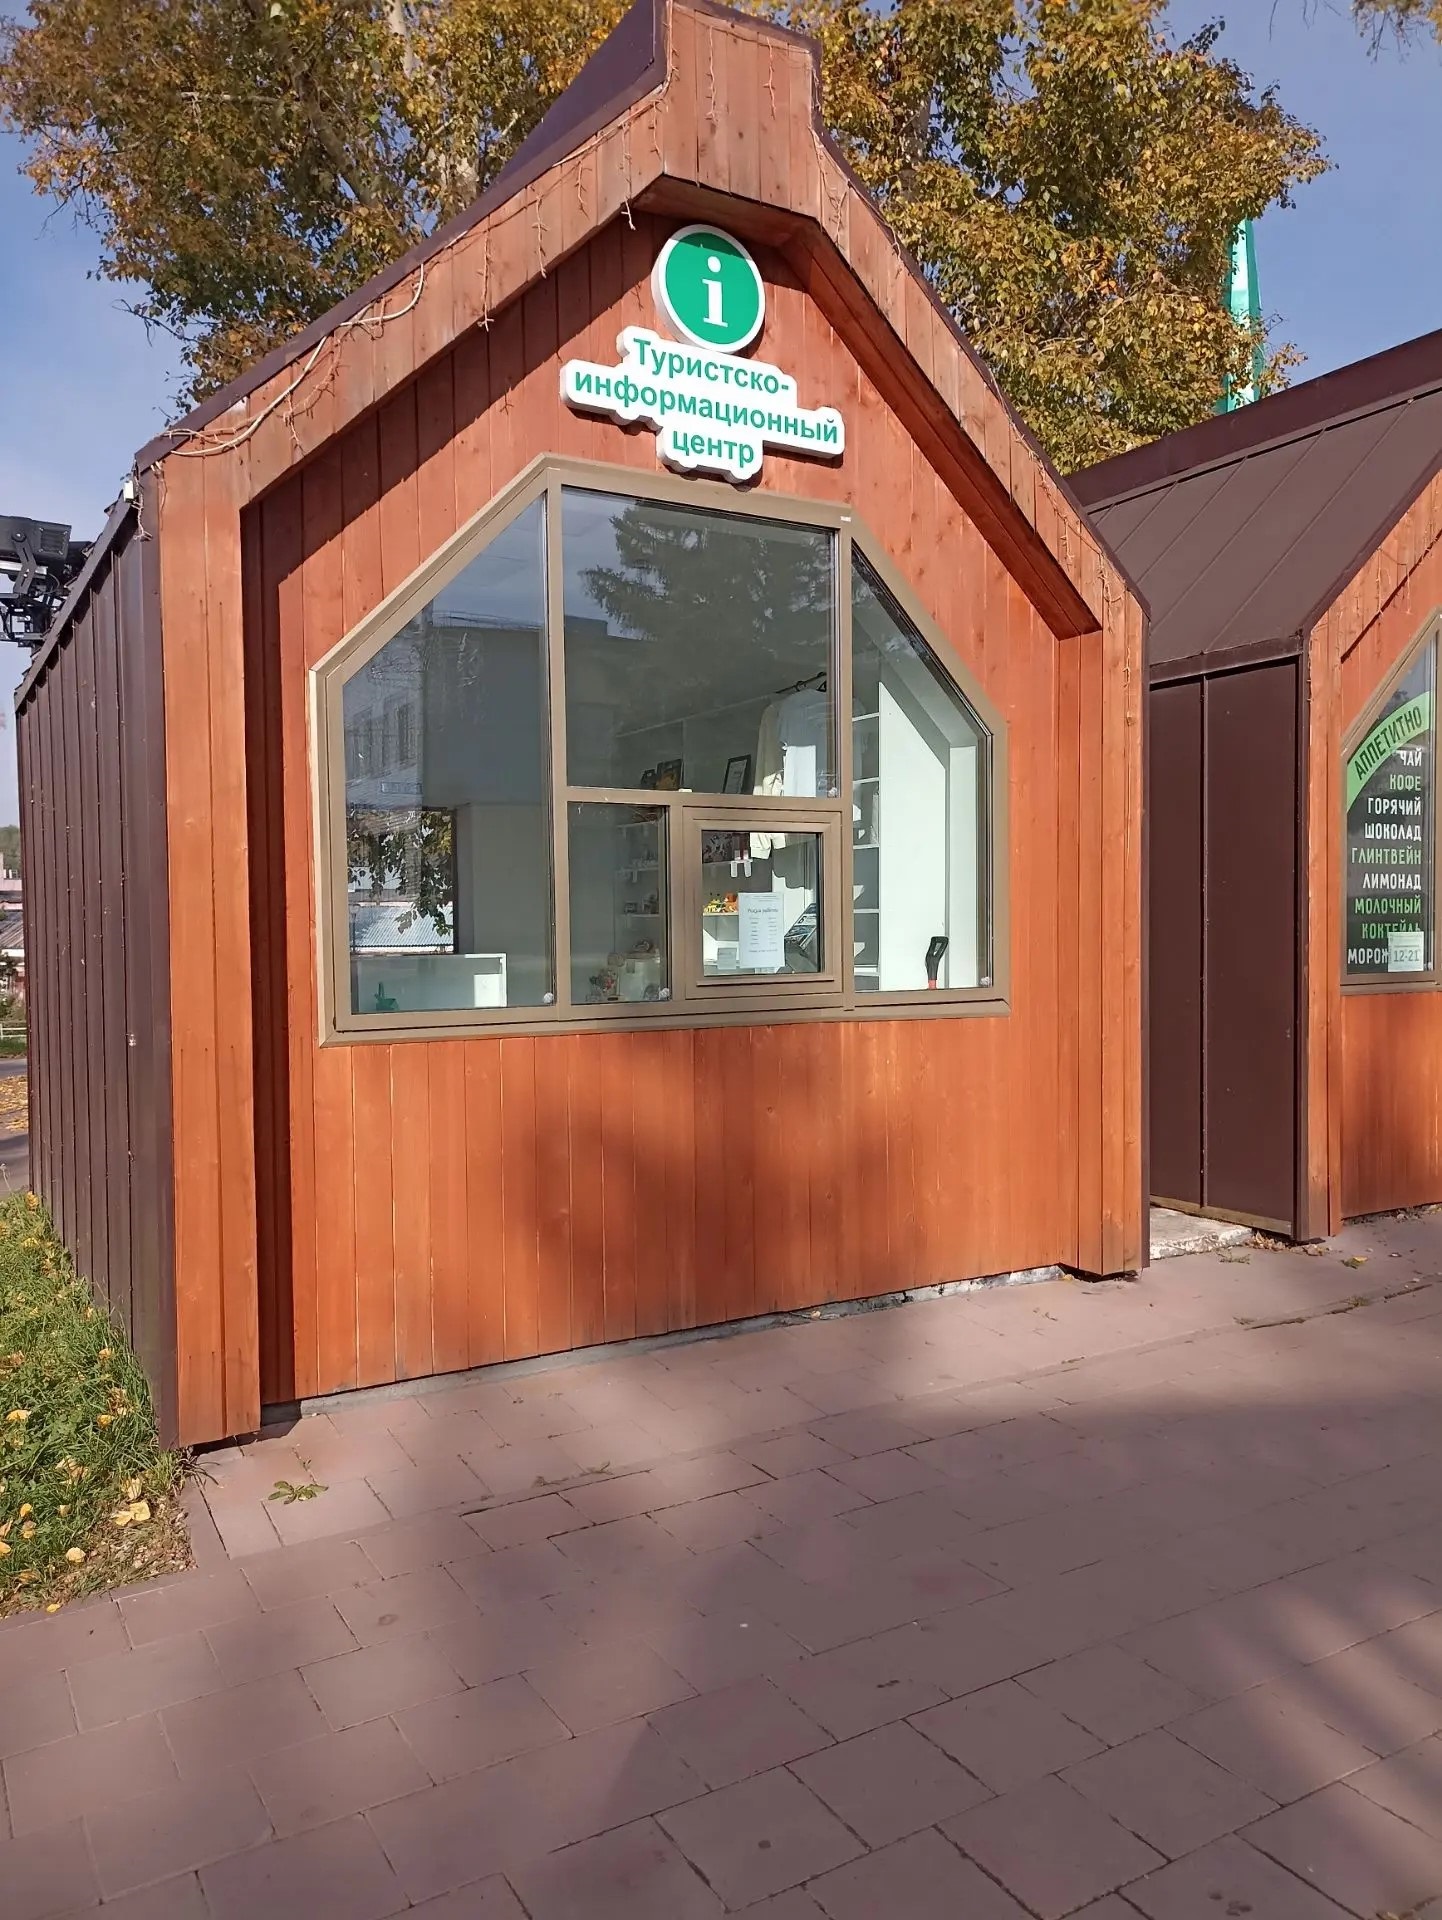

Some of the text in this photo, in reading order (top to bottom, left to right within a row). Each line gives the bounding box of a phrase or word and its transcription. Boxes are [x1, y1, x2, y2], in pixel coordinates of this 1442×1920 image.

[632, 337, 790, 394] Туристско-
[574, 370, 838, 444] информационный
[672, 429, 755, 468] центр
[1354, 705, 1423, 781] АППЕТИТНО
[1399, 747, 1422, 767] ЧАЙ
[1389, 774, 1422, 791] КОФЕ
[1367, 796, 1422, 816] ГОРЯЧИЙ
[1364, 822, 1422, 842] ШОКОЛАД
[1351, 845, 1422, 865] ГЛИНТВЕЙН
[1362, 872, 1422, 891] ЛИМОНАД
[1354, 894, 1422, 914] МОЛОЧНЫЙ
[1347, 947, 1391, 965] МОРОЖ
